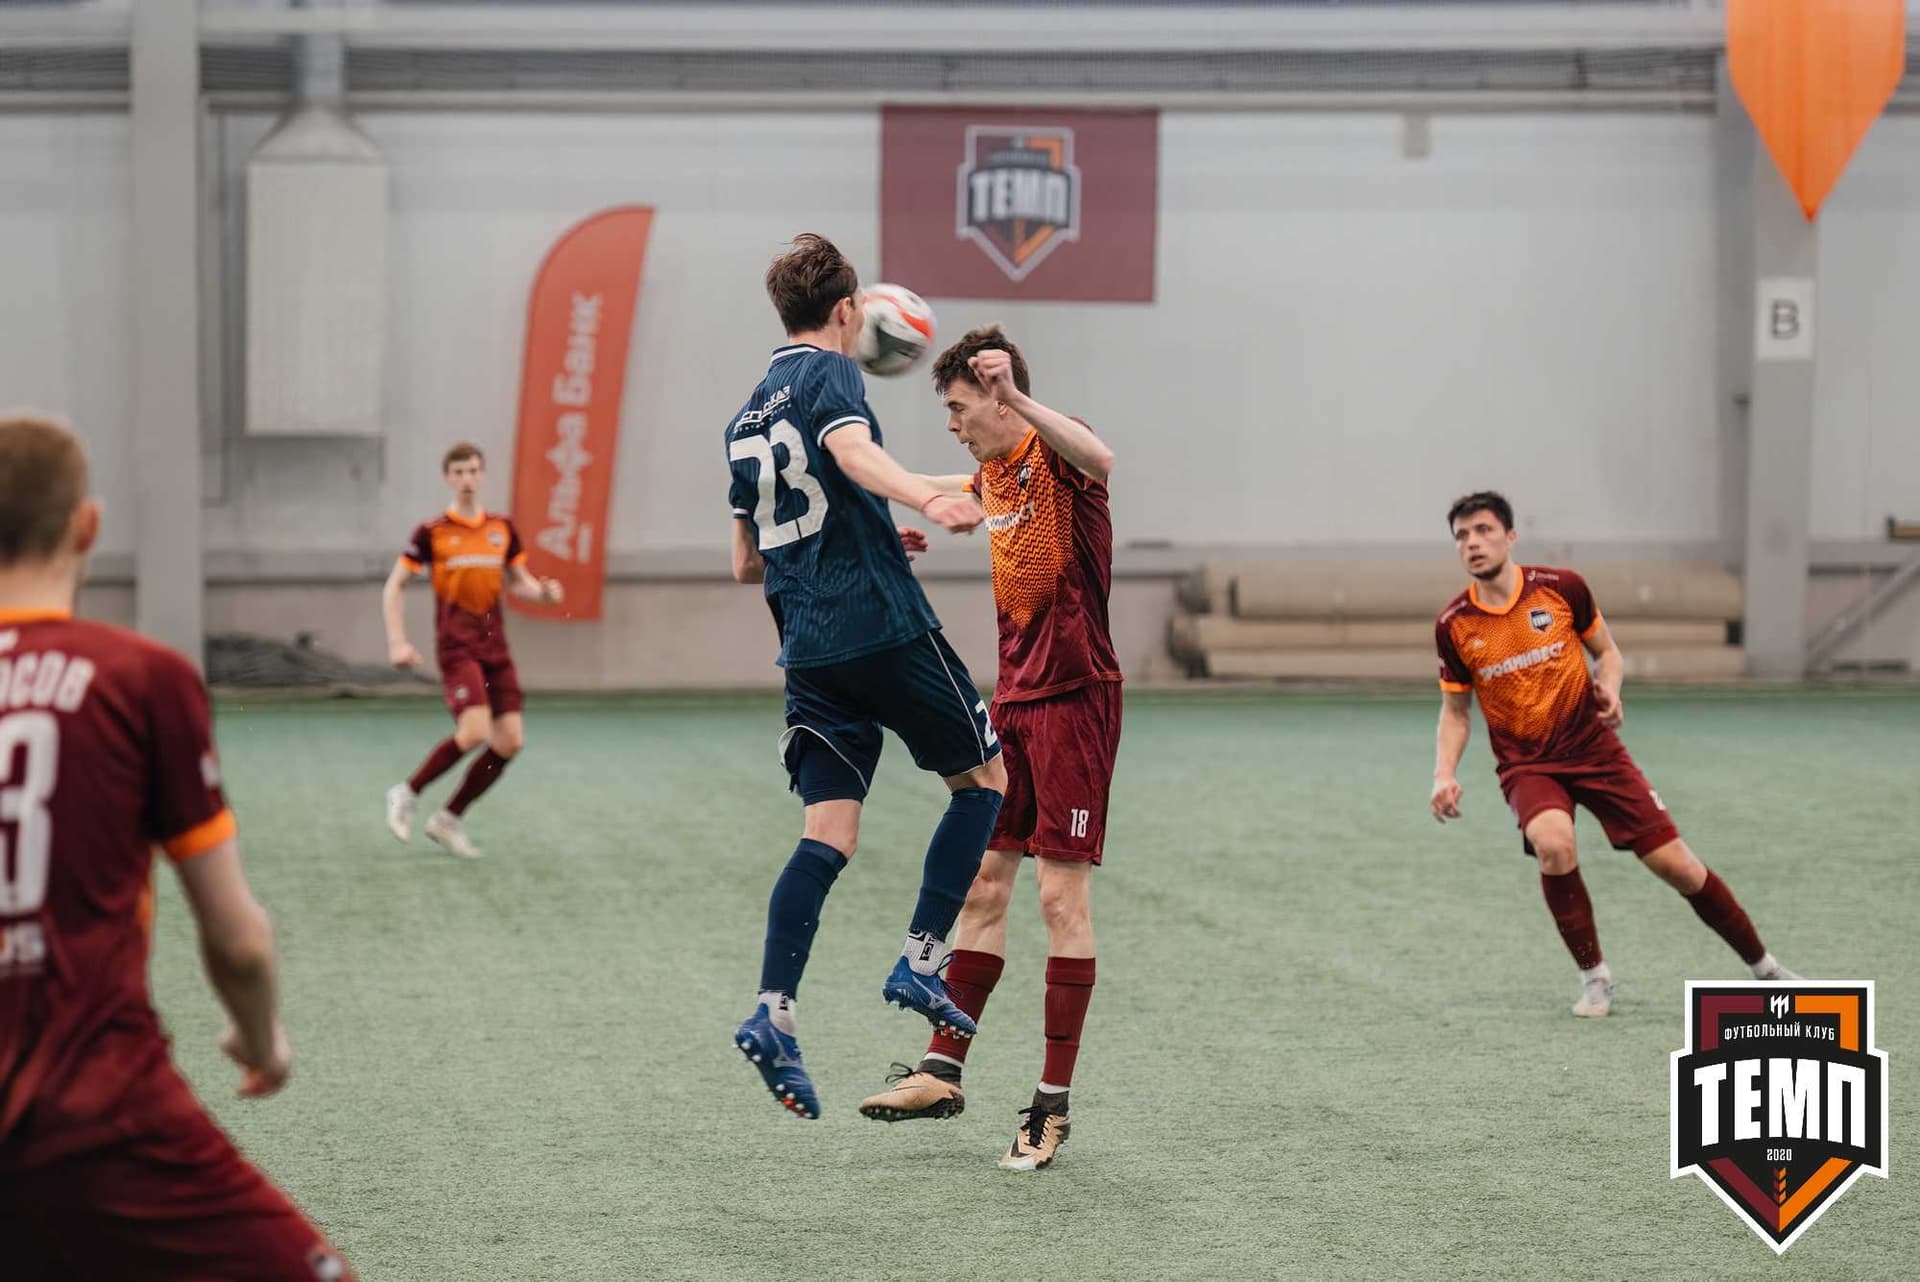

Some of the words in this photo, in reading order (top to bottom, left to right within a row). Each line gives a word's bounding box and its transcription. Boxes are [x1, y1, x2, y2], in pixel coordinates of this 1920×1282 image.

[970, 167, 1069, 222] ТЕМП
[552, 290, 603, 407] Банк
[536, 411, 592, 562] Альфа
[729, 418, 829, 550] 23
[1070, 808, 1090, 839] 18
